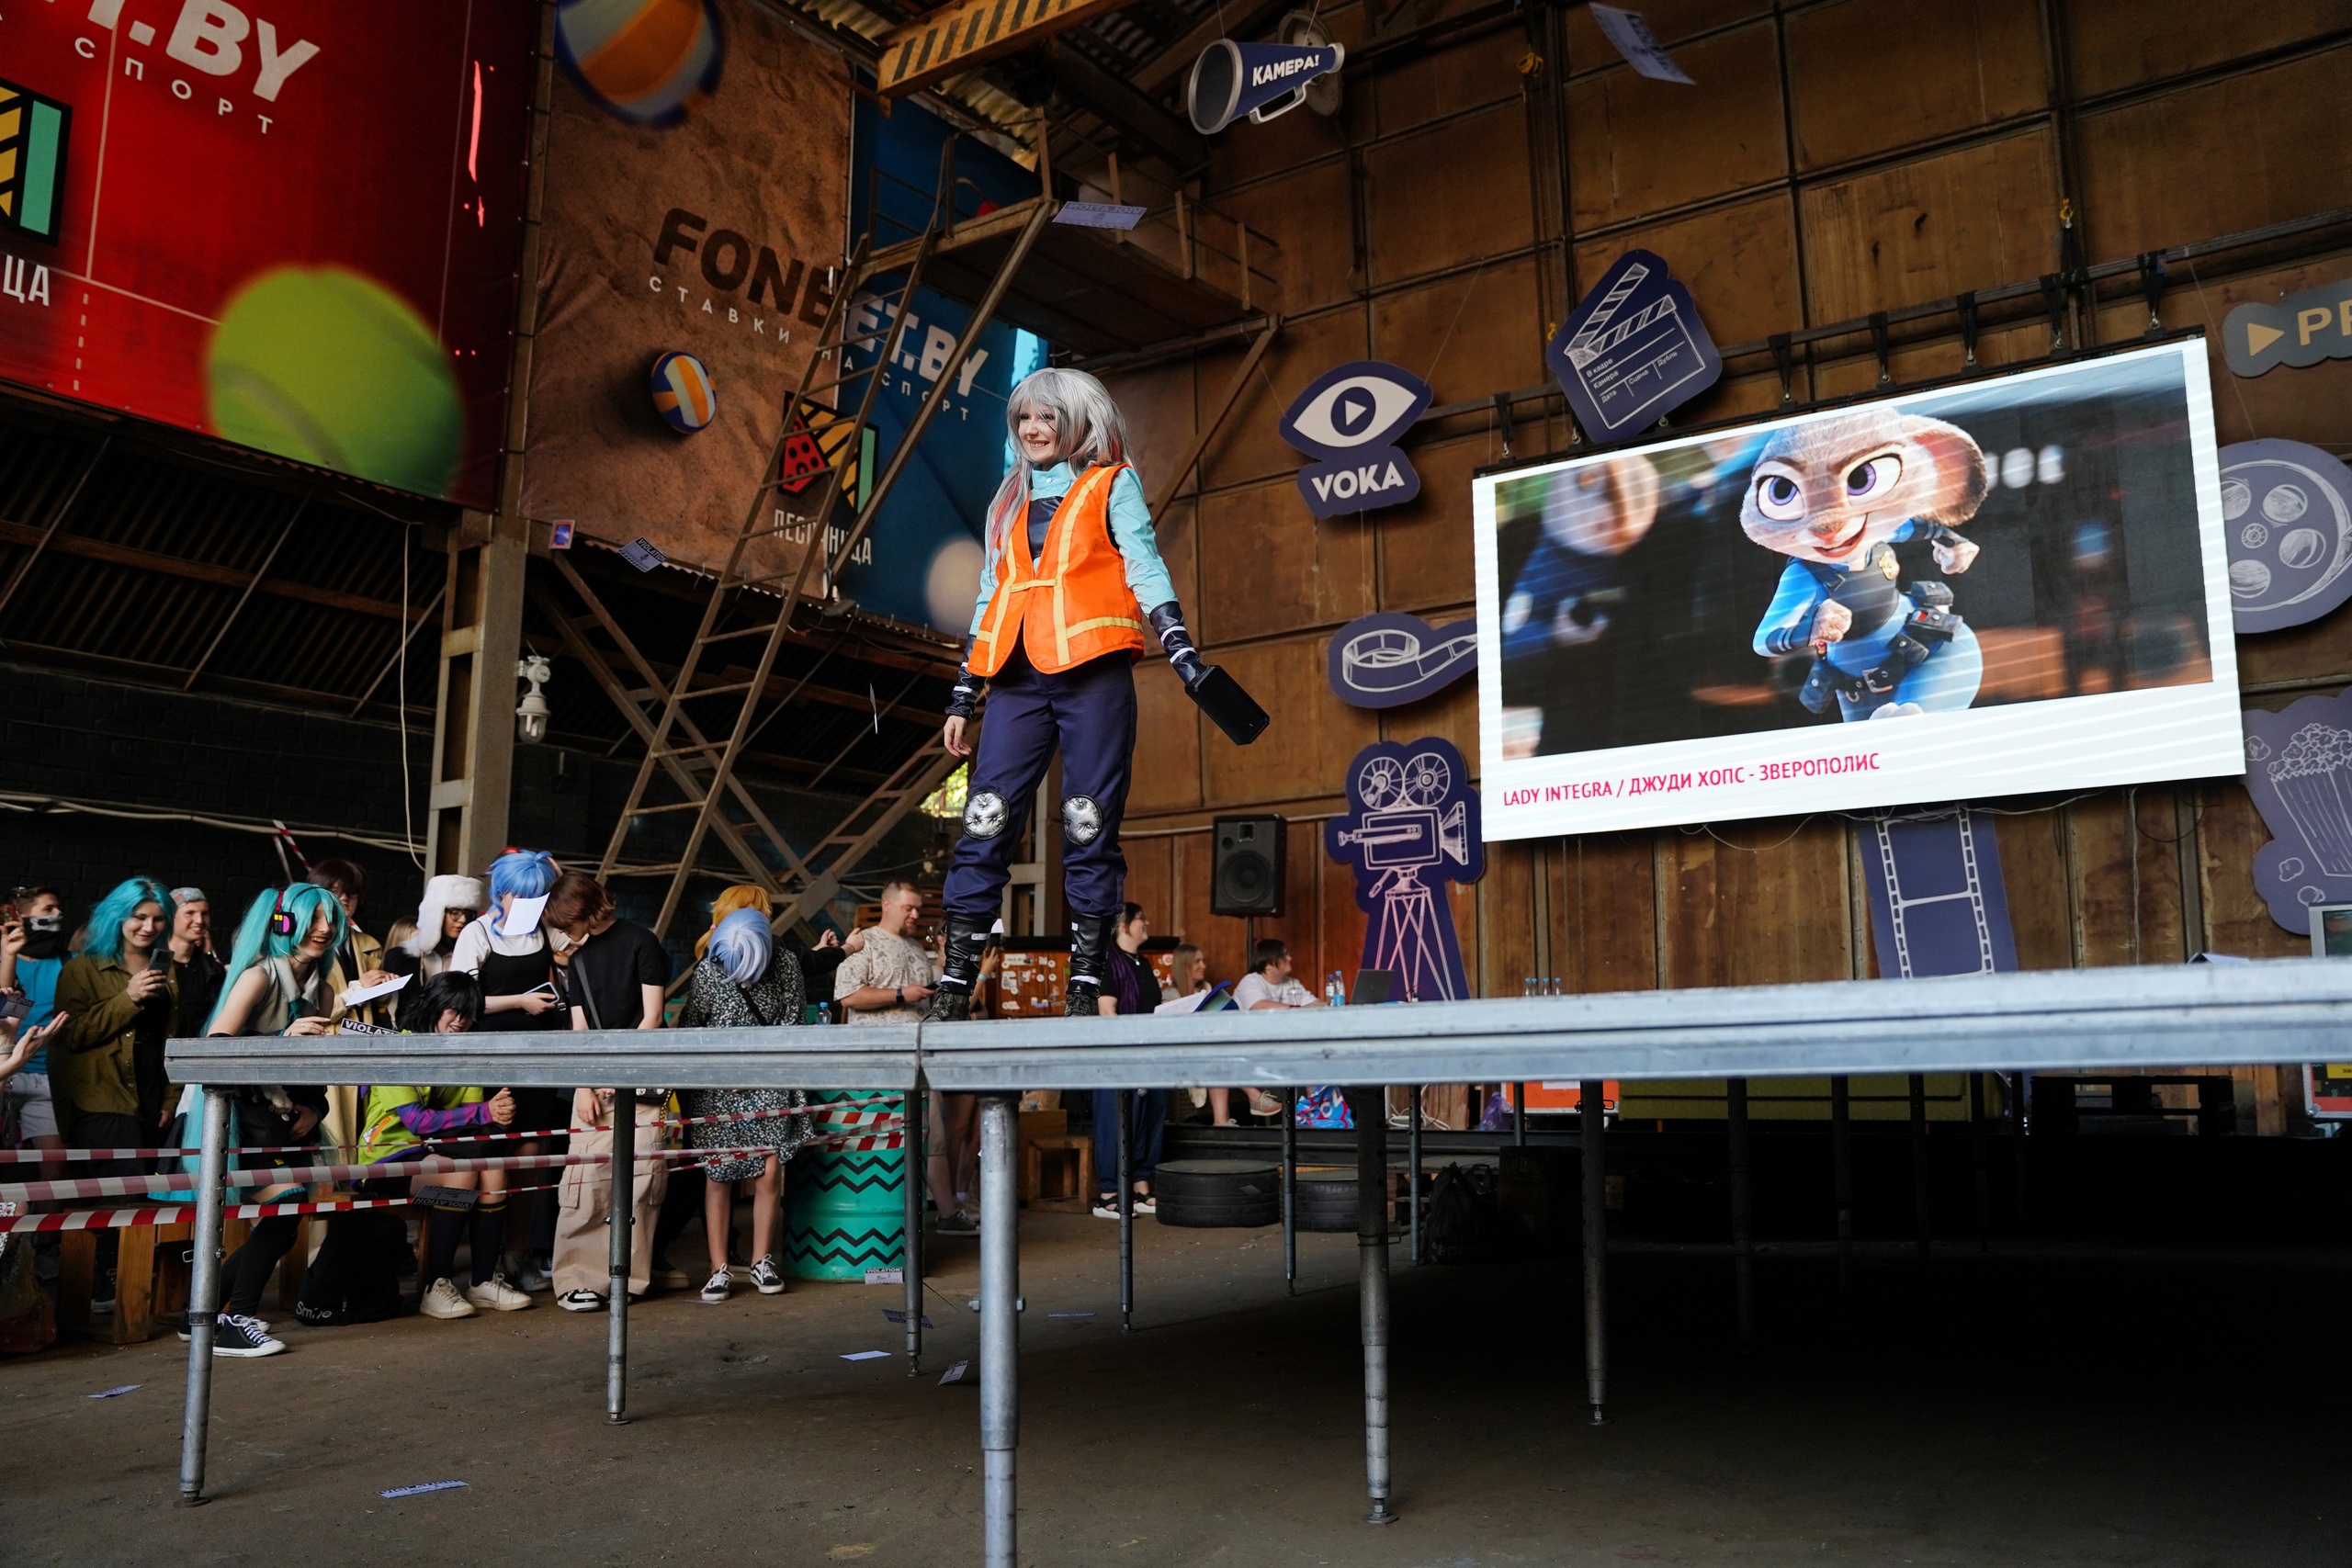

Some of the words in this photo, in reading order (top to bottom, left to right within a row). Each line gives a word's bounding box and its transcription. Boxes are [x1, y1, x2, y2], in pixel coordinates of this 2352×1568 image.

[1252, 54, 1320, 87] КАМЕРА!
[74, 37, 274, 135] СПОРТ
[649, 276, 790, 345] СТАВКИ
[1593, 369, 1620, 389] Камера
[1628, 369, 1649, 385] Сцена
[1600, 389, 1618, 404] Дата
[1311, 460, 1406, 503] VOKA
[1504, 788, 1540, 806] LADY
[1545, 781, 1612, 802] INTEGRA
[1616, 779, 1624, 798] /
[1628, 773, 1692, 796] ДЖУДИ
[1698, 767, 1745, 787] ХОПС
[1758, 752, 1880, 781] ЗВЕРОПОЛИС
[345, 1020, 396, 1034] VIOLAT
[414, 1198, 469, 1209] VIOLATION
